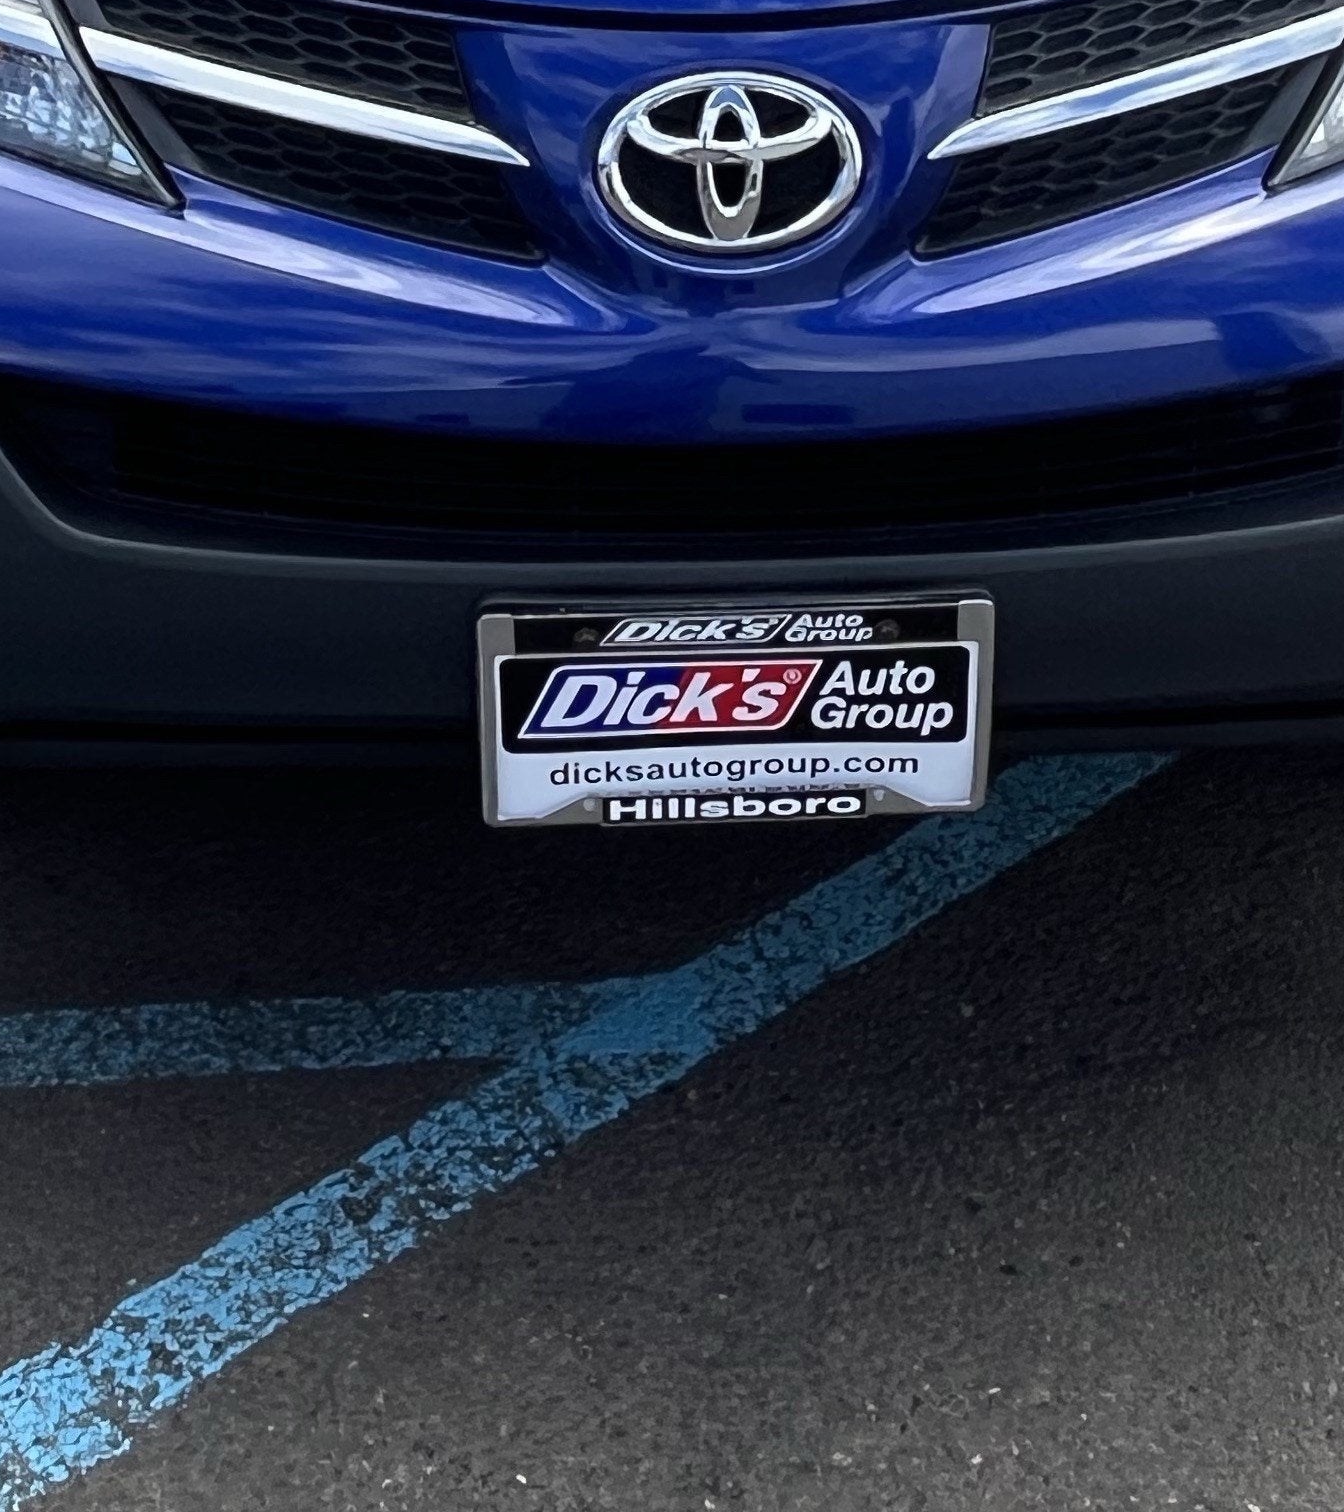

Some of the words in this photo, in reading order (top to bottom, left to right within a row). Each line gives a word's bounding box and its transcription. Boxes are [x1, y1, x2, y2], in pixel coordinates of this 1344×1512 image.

[614, 617, 779, 642] Dick's
[784, 627, 874, 643] Group
[796, 614, 864, 628] Auto
[819, 660, 936, 696] Auto
[540, 668, 788, 729] Dick's
[810, 696, 954, 736] Group
[549, 755, 919, 786] dicksautogroup.com
[609, 794, 862, 822] Hillsboro
